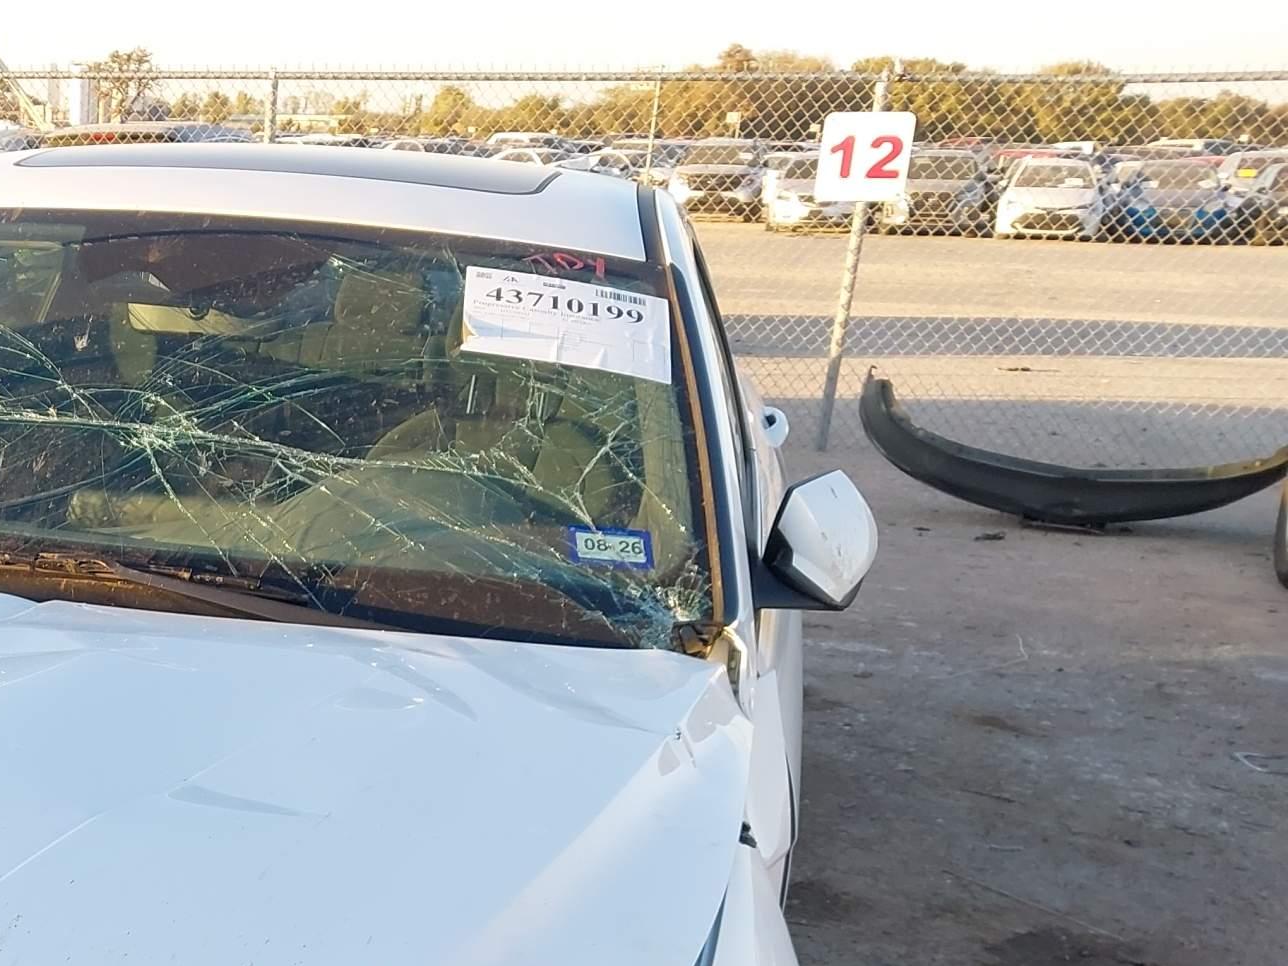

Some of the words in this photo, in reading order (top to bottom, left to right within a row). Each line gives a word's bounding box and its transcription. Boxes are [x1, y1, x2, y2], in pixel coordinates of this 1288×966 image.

[830, 135, 903, 178] 12
[486, 287, 644, 323] 43710199
[584, 537, 608, 552] 08
[618, 540, 643, 555] 26
